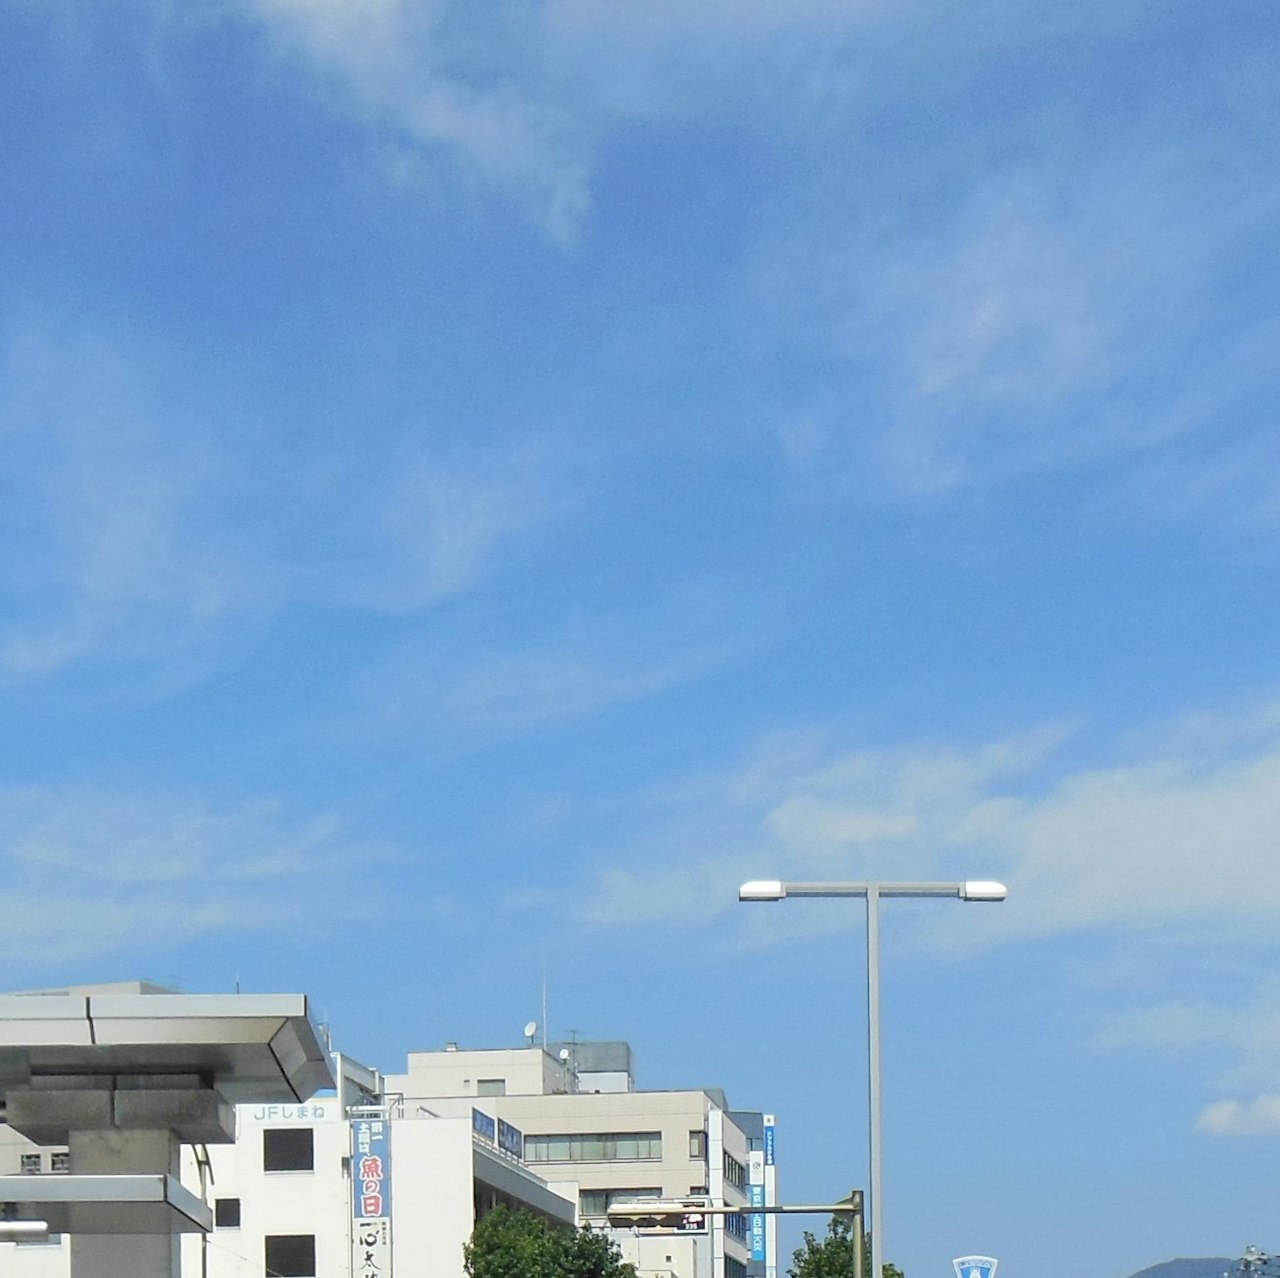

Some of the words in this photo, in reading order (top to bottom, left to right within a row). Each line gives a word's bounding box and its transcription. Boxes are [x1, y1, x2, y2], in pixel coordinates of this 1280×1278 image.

[253, 1105, 325, 1120] JFしまね
[359, 1156, 384, 1217] 魚の日
